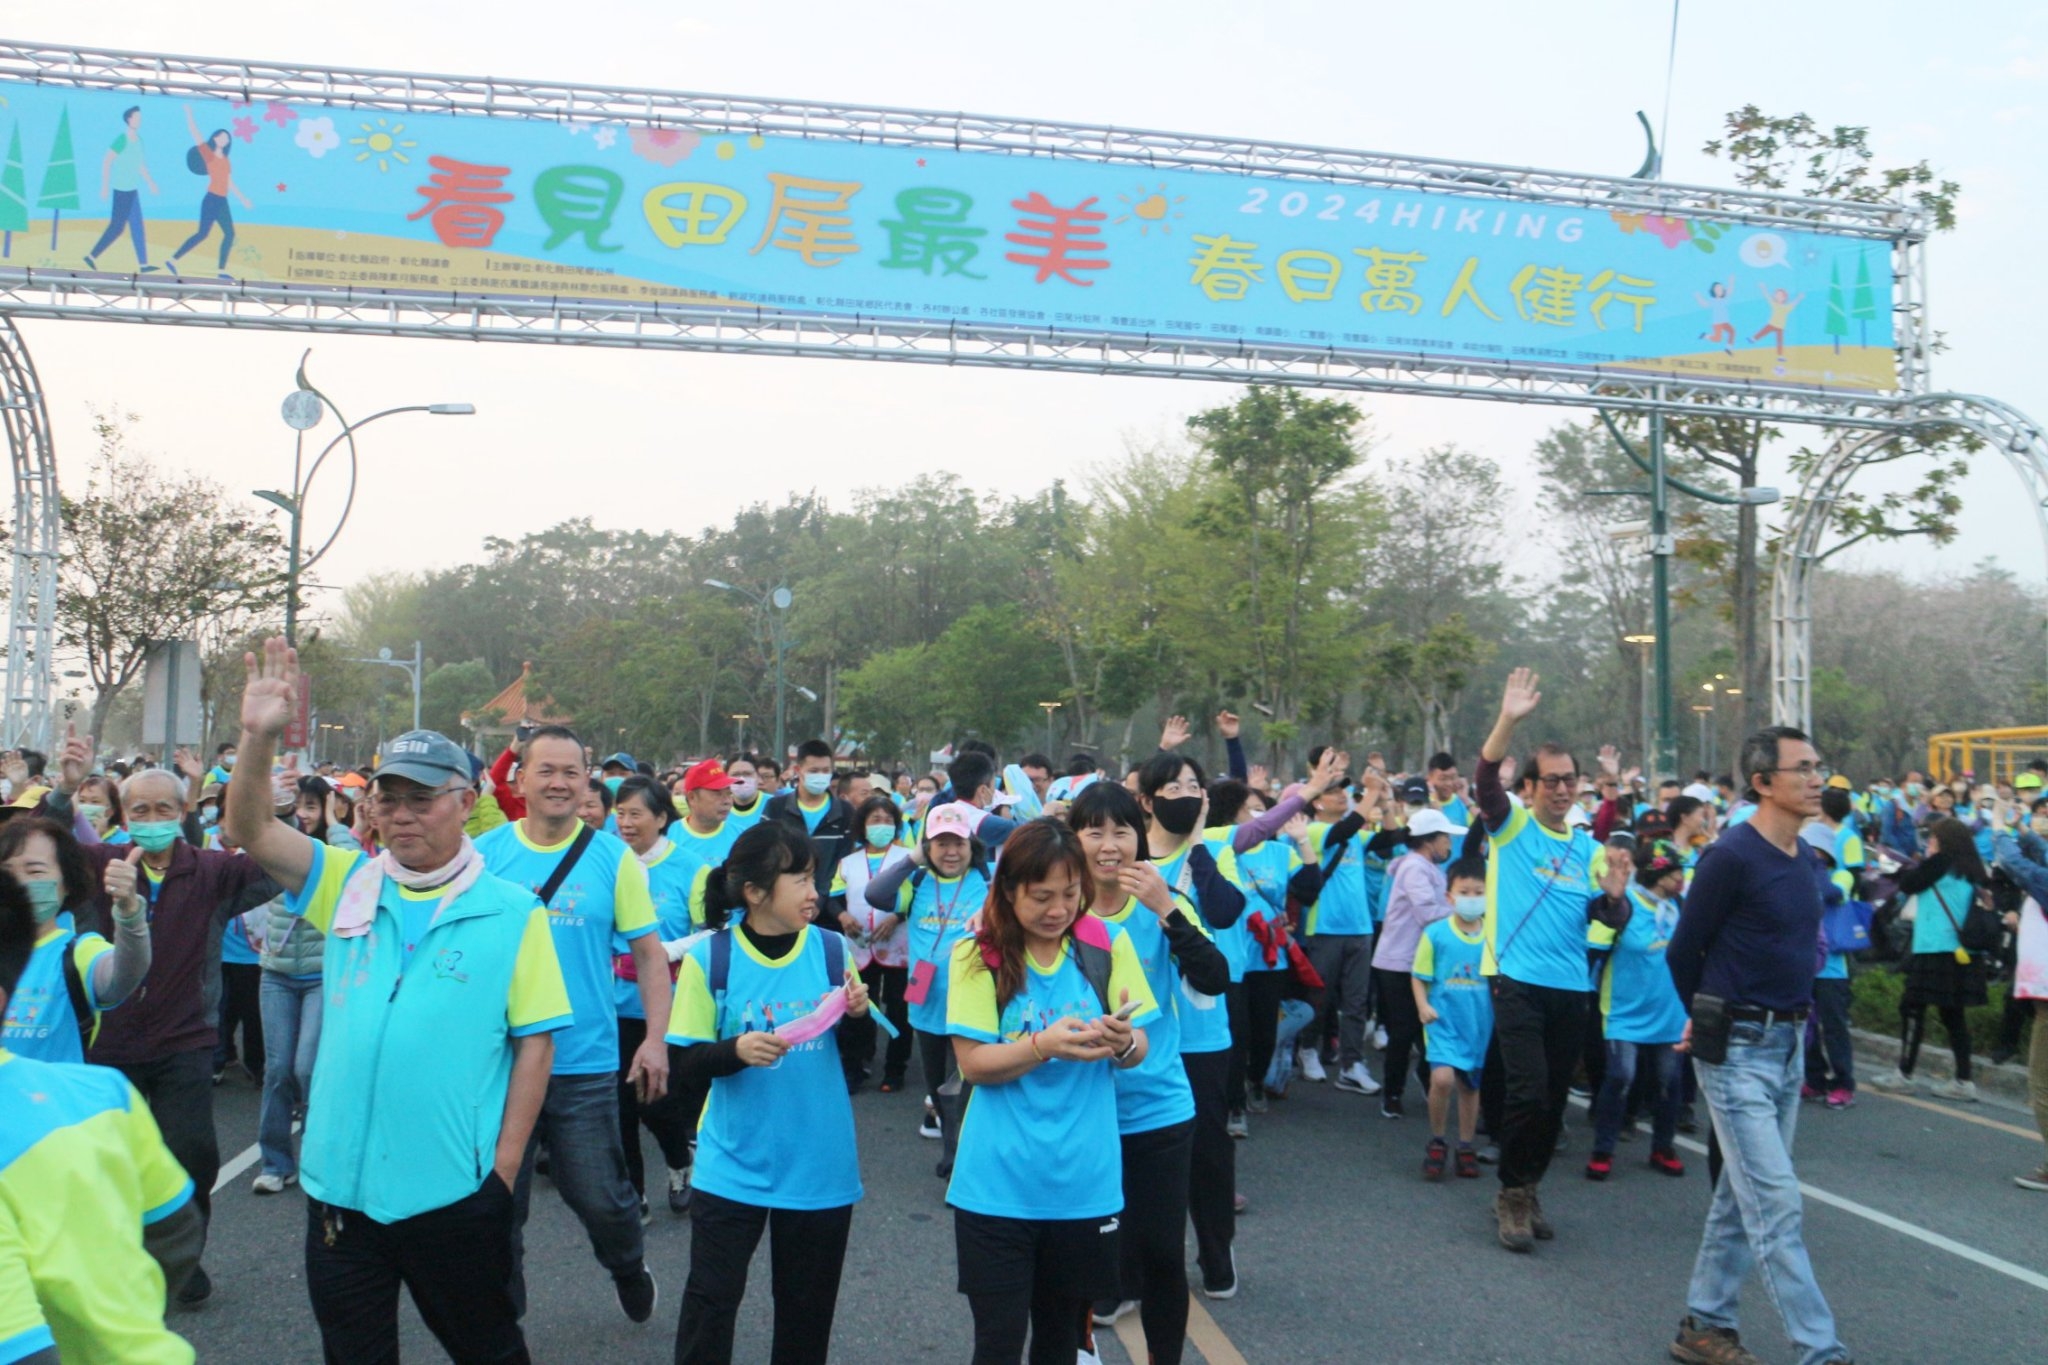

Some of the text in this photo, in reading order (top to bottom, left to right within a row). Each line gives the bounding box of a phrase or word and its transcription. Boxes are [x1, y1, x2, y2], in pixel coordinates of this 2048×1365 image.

[407, 155, 1111, 287] 看見田尾最美
[1188, 233, 1656, 333] 春日萬人健行
